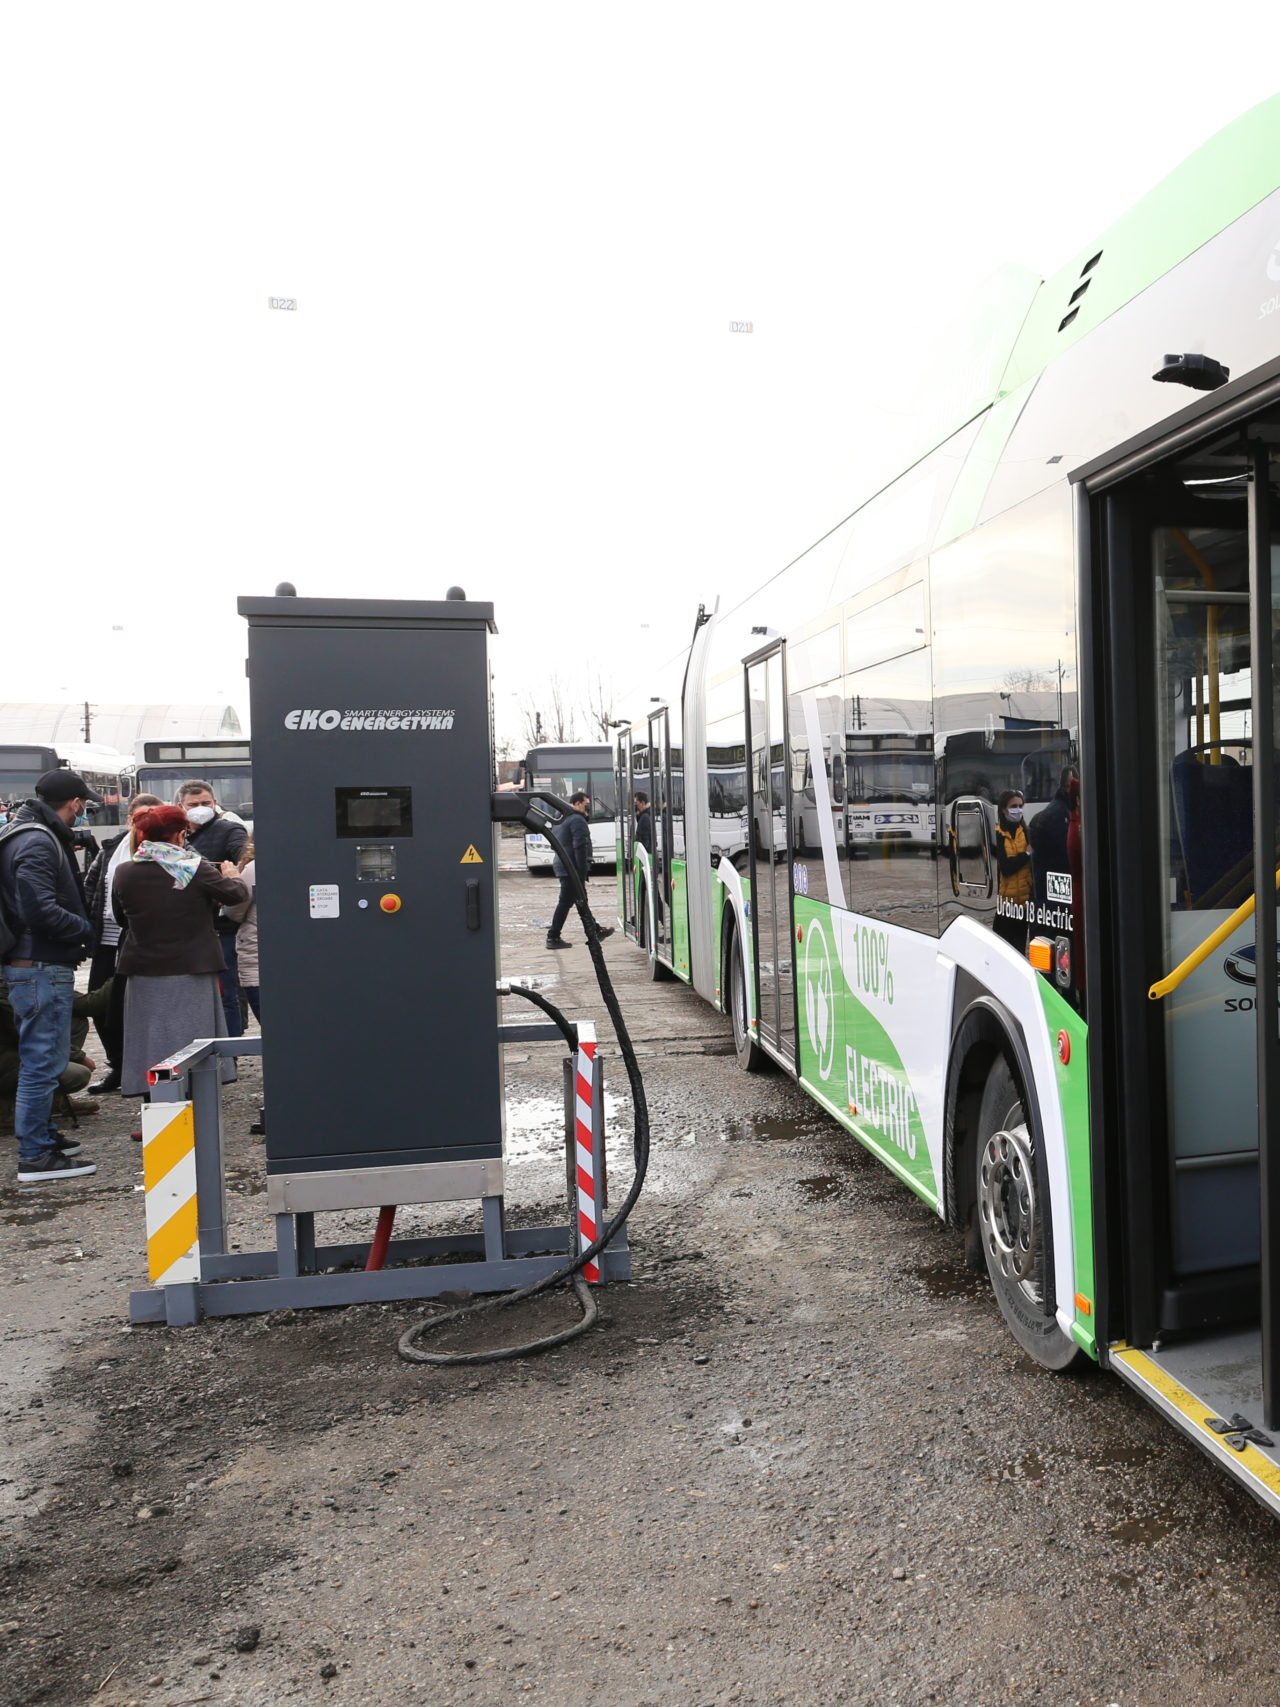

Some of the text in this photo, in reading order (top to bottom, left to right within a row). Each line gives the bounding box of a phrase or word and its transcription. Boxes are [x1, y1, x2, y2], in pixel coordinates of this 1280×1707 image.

[284, 709, 454, 731] EKO ENERGETYKA
[343, 709, 456, 717] SMART ENERGY SYSTEMS
[996, 894, 1074, 931] Urbino 18 electric
[853, 923, 894, 1005] 100%
[846, 1044, 916, 1161] ELECTRIC
